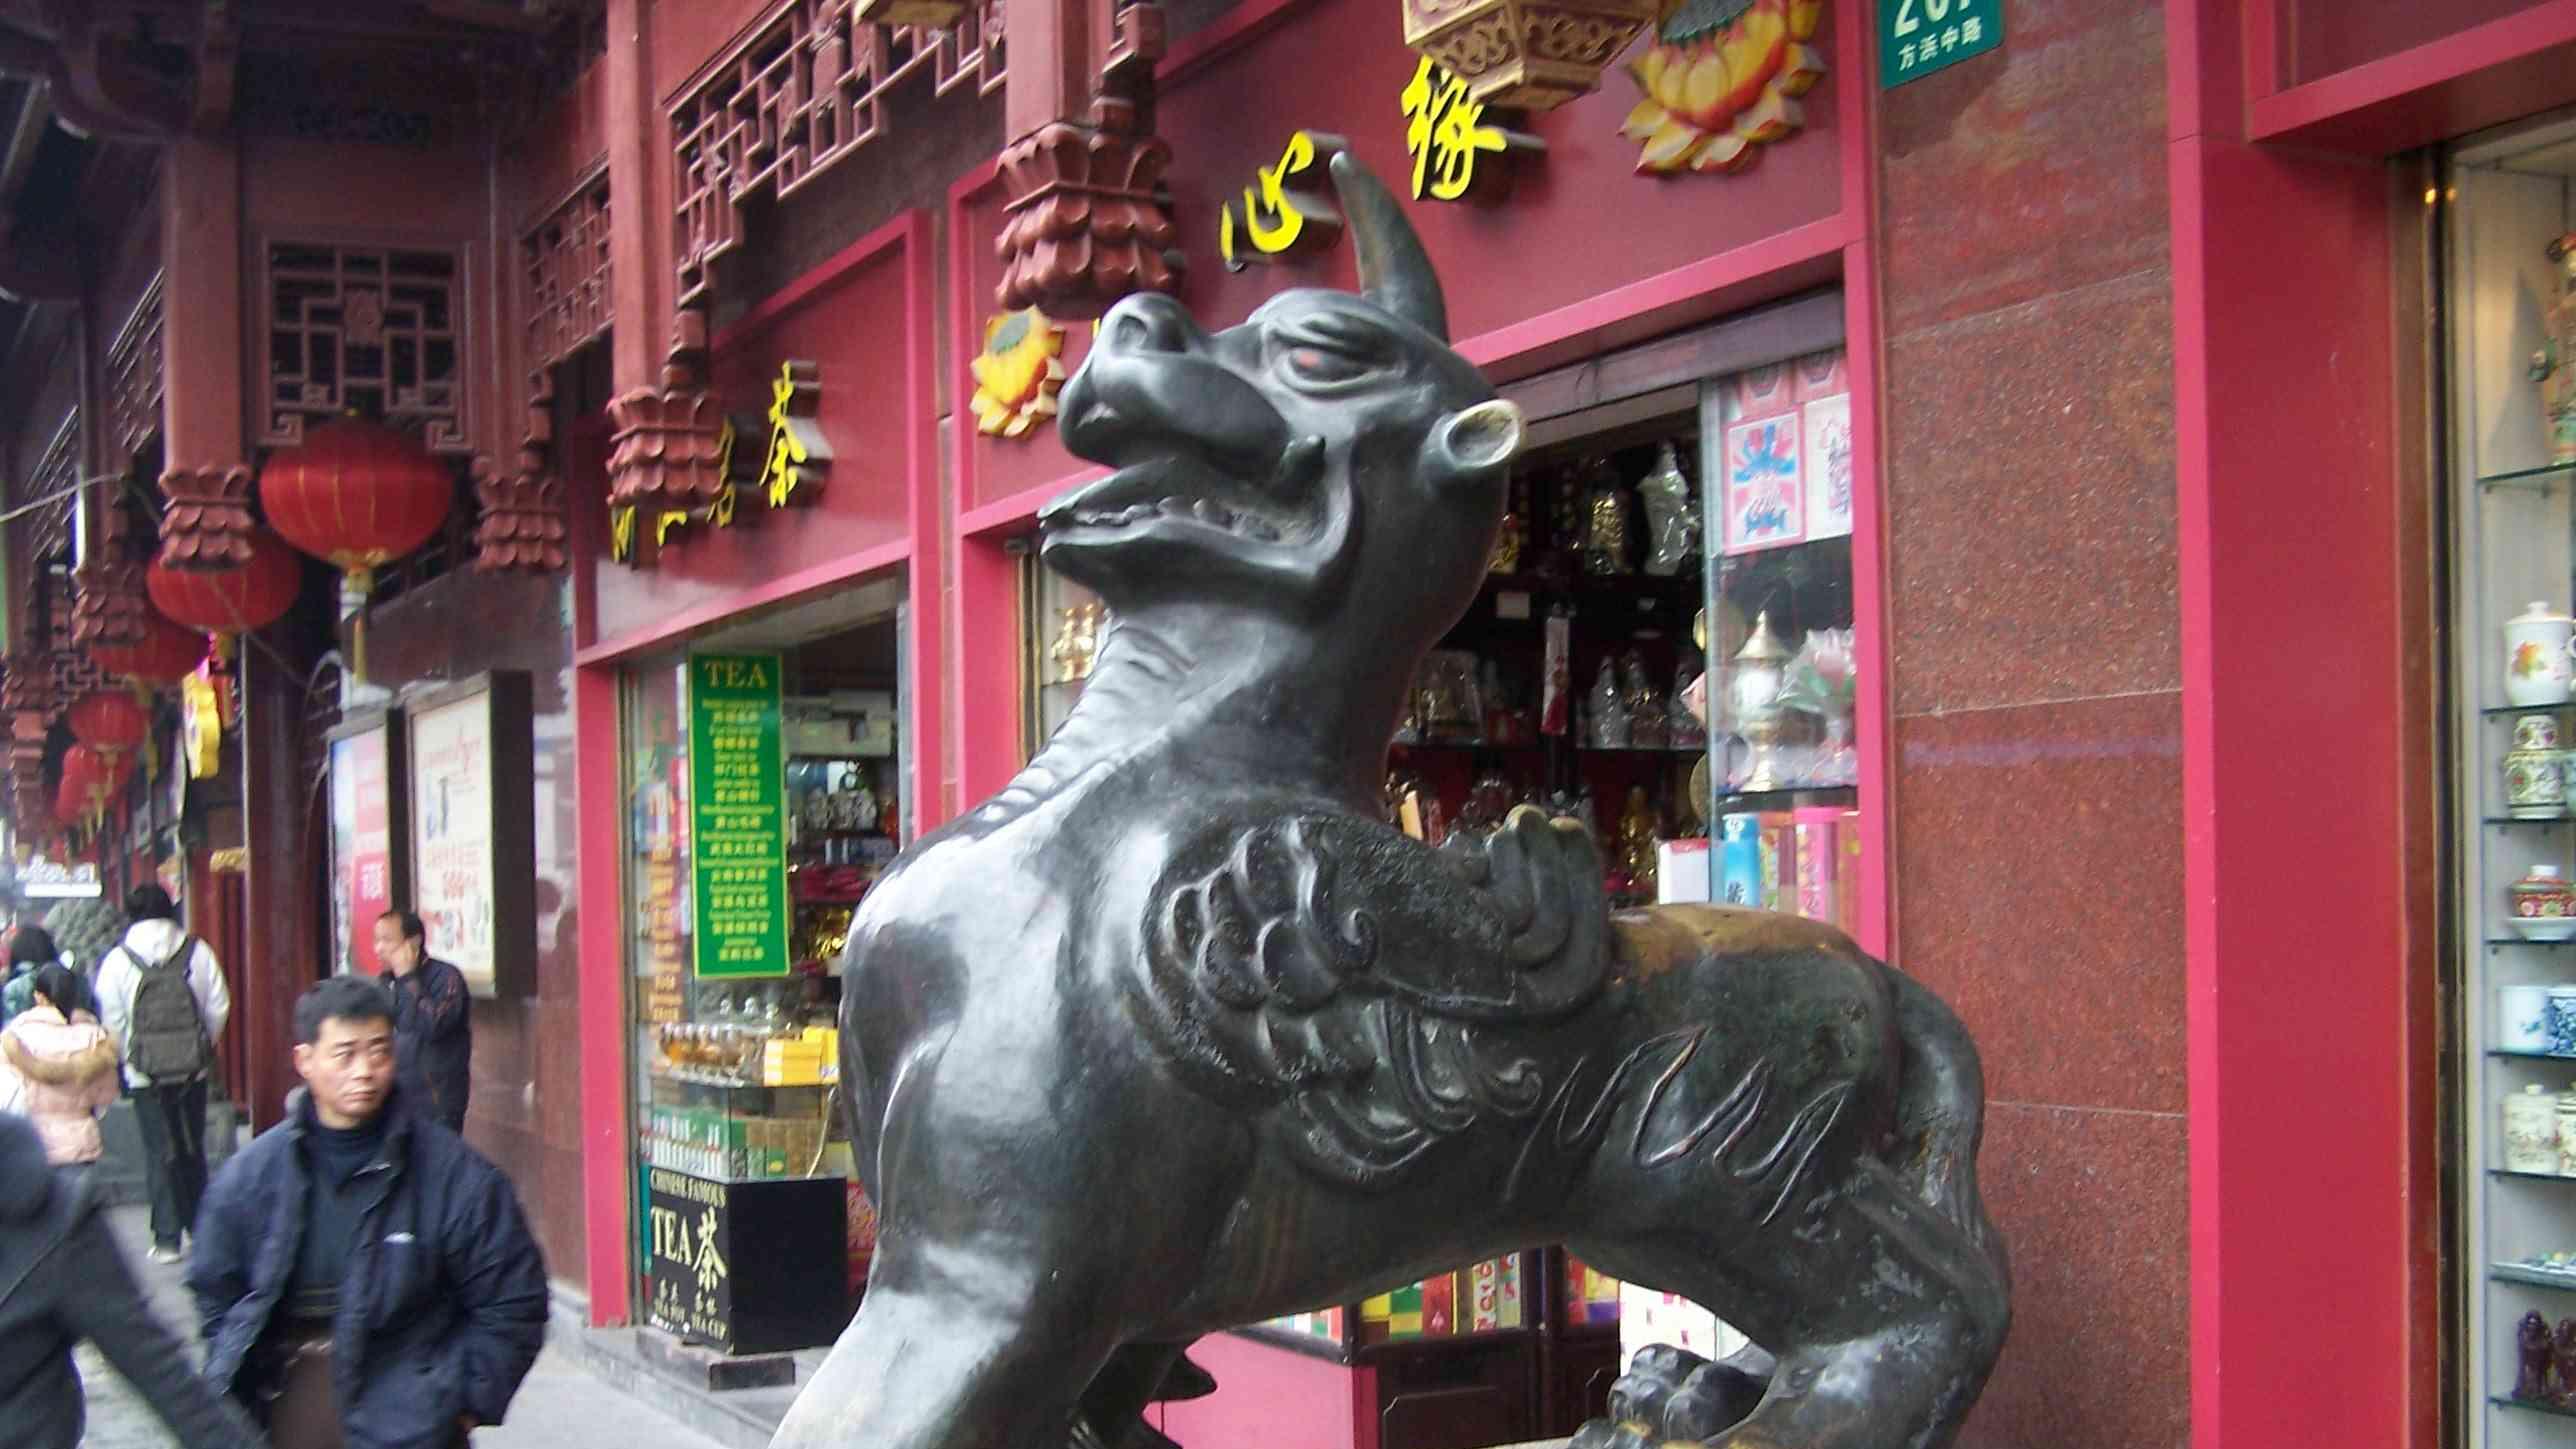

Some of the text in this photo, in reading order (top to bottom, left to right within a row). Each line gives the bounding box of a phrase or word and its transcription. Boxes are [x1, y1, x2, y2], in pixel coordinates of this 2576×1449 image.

[704, 661, 768, 689] TEA
[651, 1206, 728, 1292] TEA 茶
